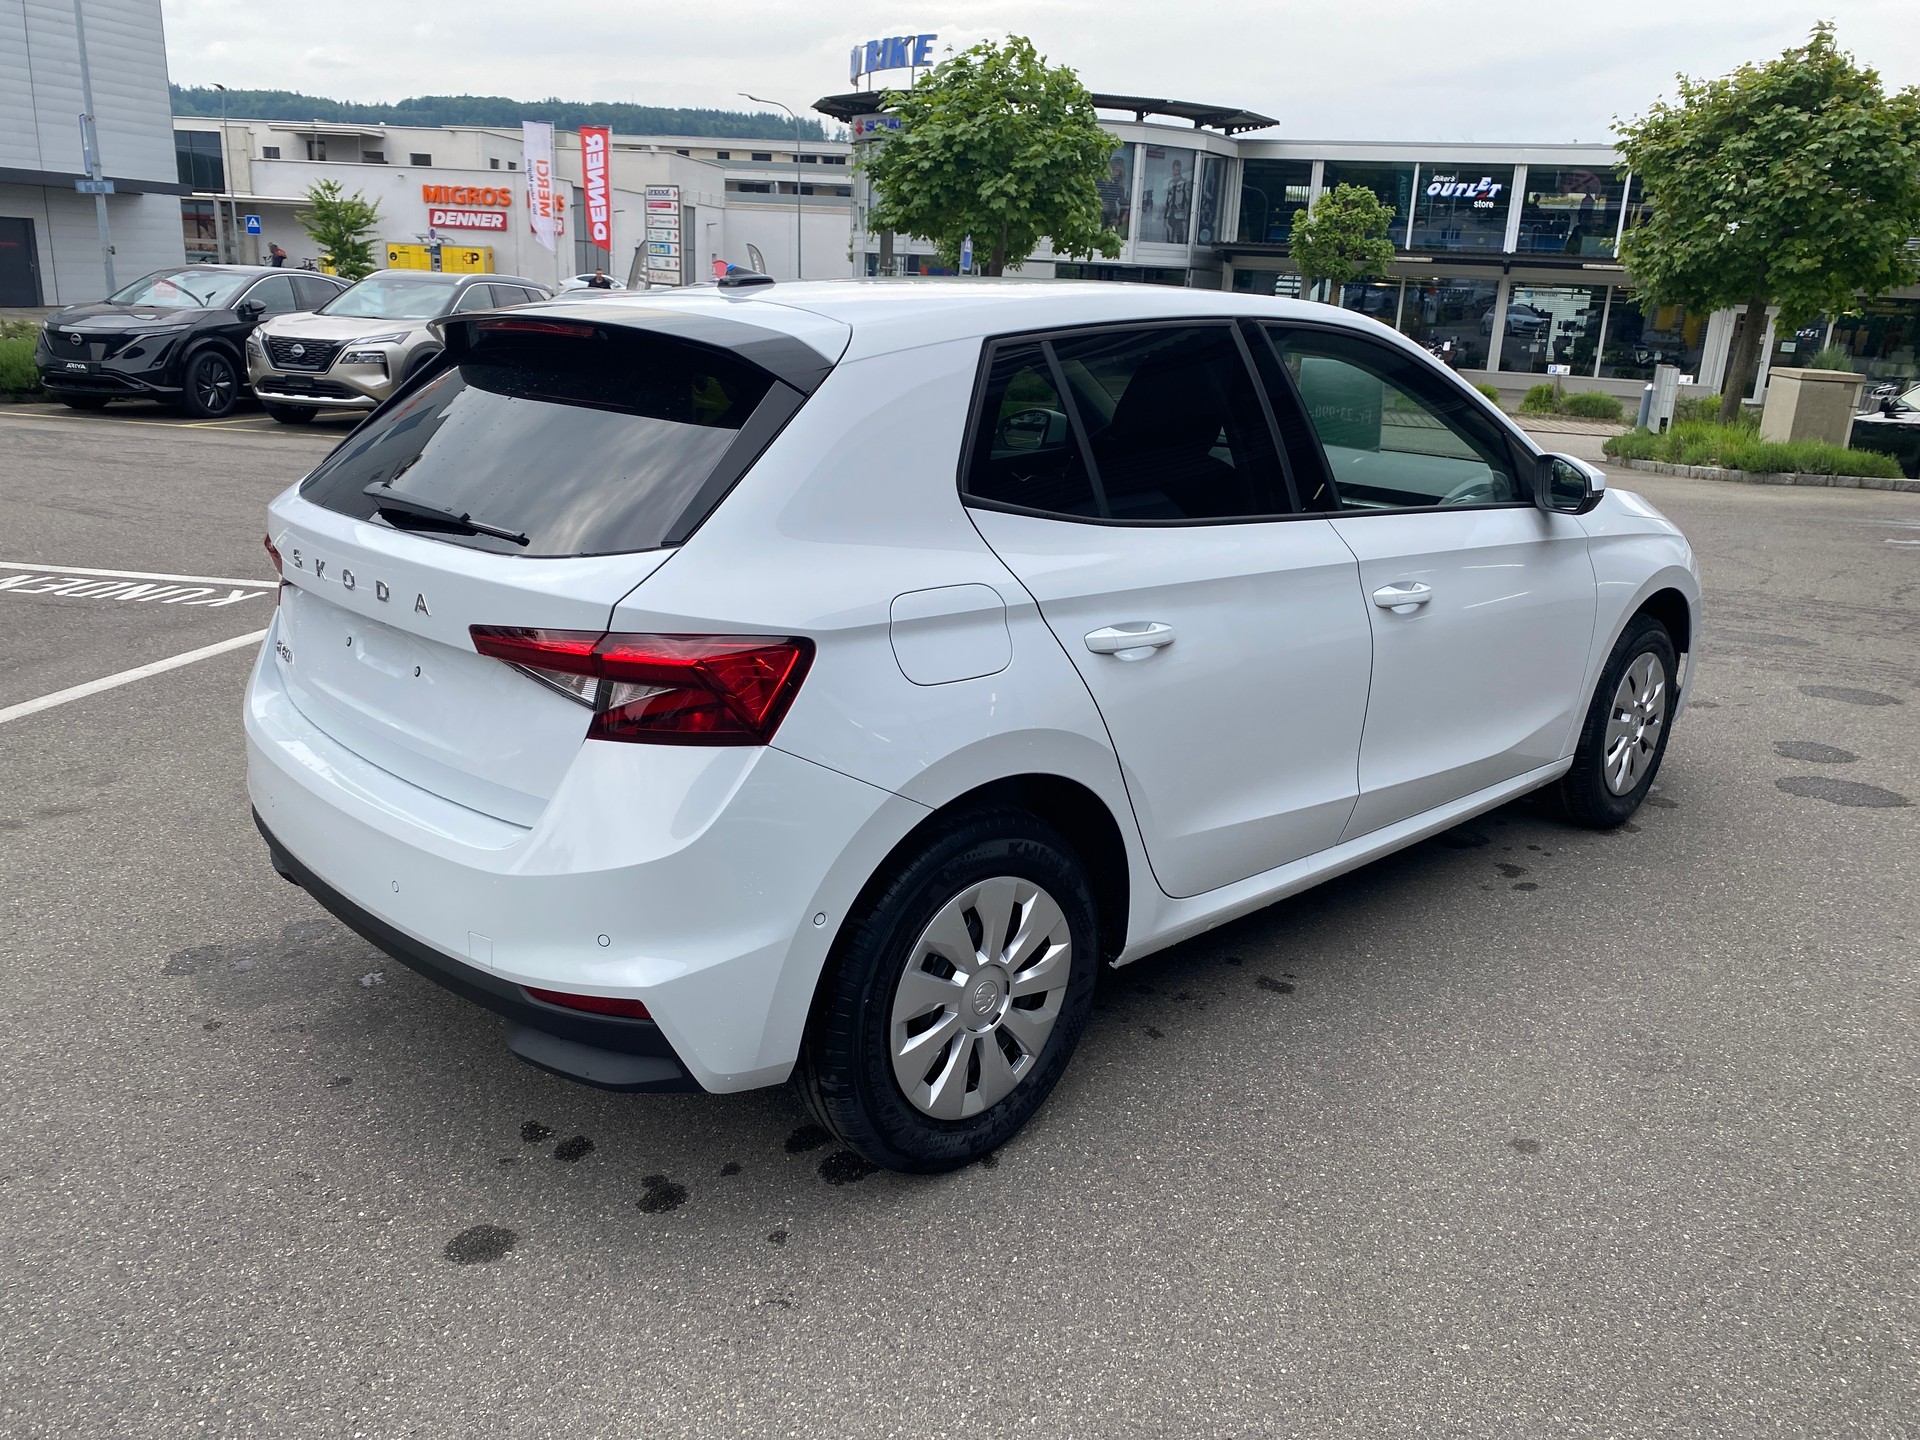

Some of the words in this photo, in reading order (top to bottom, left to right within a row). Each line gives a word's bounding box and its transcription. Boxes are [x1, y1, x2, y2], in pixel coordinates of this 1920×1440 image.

[865, 34, 938, 73] BIKE
[1432, 174, 1456, 182] Biker's
[422, 184, 512, 207] MIGROS
[1427, 176, 1502, 198] OUTLET
[1473, 200, 1494, 208] store
[432, 211, 504, 228] DENNER
[65, 362, 87, 370] ARIYA
